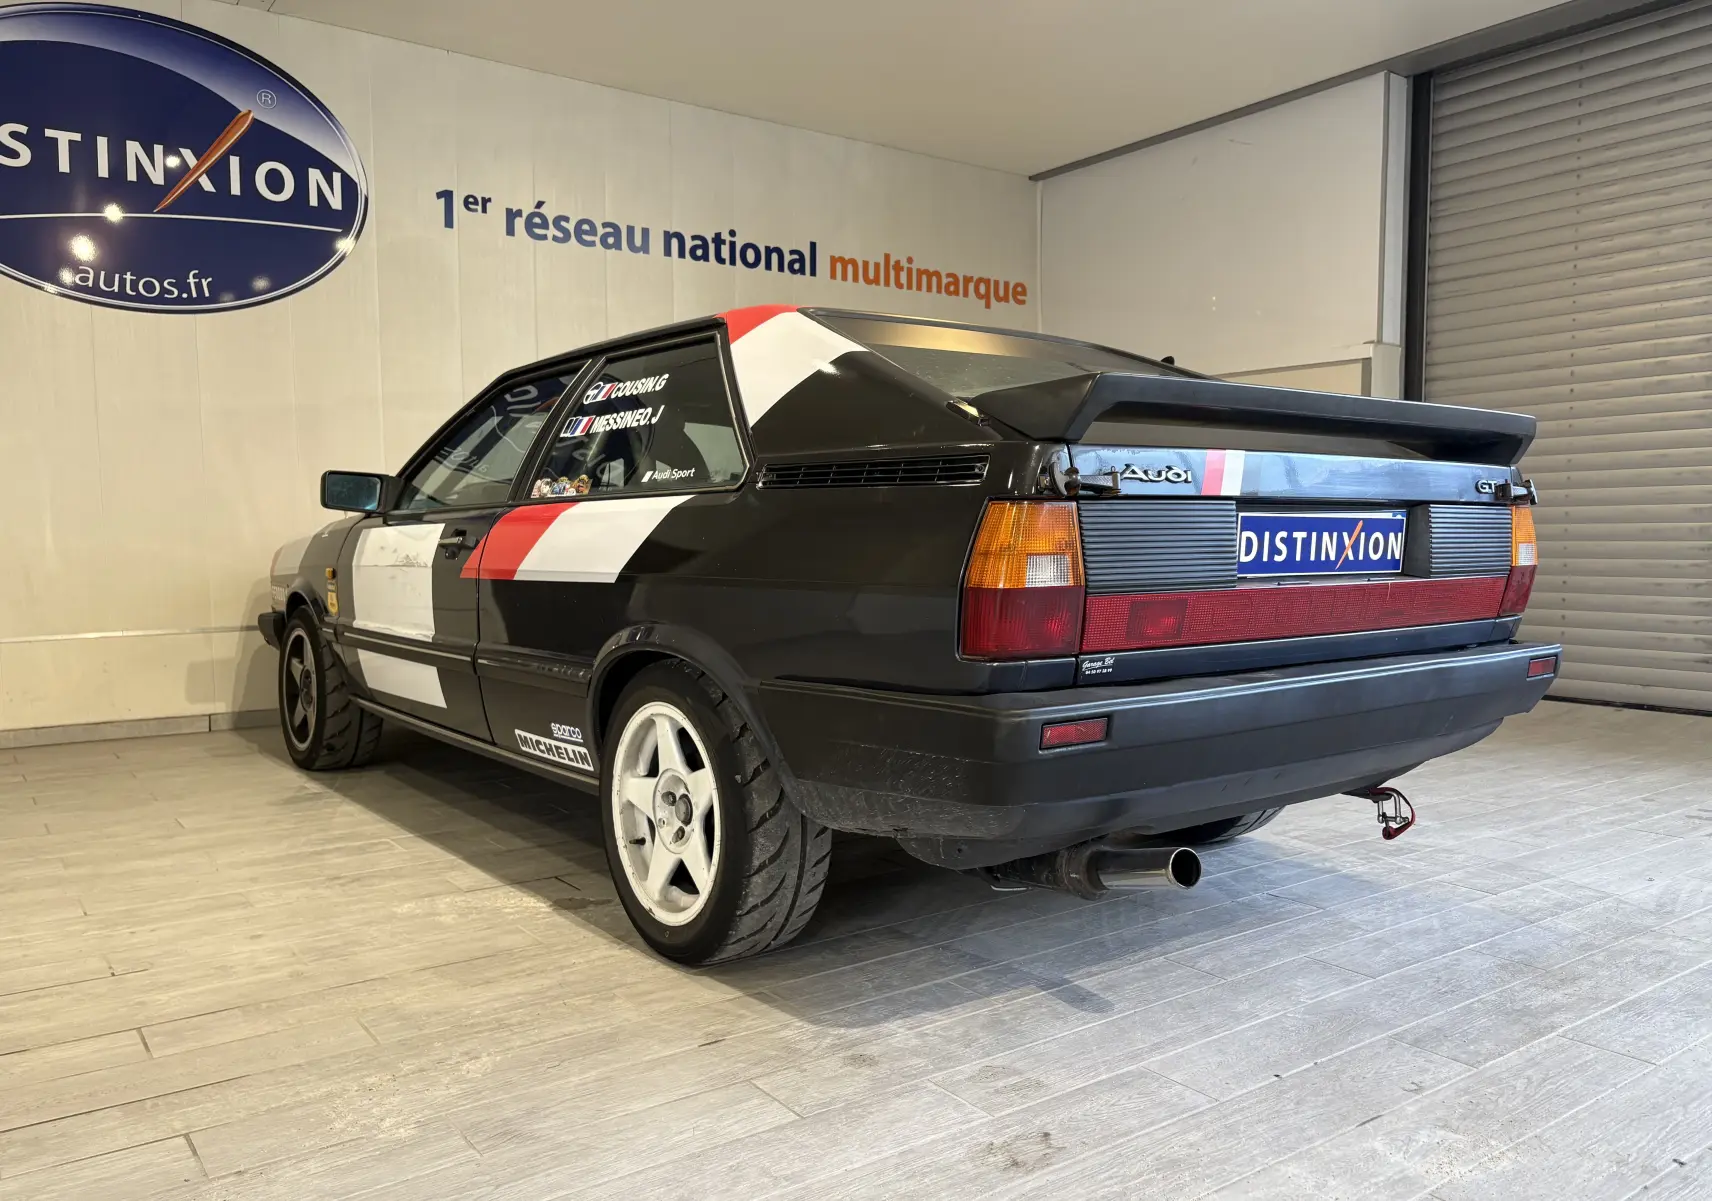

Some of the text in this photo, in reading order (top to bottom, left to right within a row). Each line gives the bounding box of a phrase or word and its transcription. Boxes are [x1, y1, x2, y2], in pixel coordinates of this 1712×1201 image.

[505, 202, 651, 255] réseau
[663, 229, 818, 277] national
[829, 252, 1028, 309] multimarque
[75, 265, 213, 298] autos.fr
[651, 467, 696, 480] Audi Sport
[1120, 463, 1193, 484] Audi
[1239, 523, 1403, 568] DISTINXION
[551, 722, 583, 739] sparco
[516, 732, 592, 768] MICHELIN
